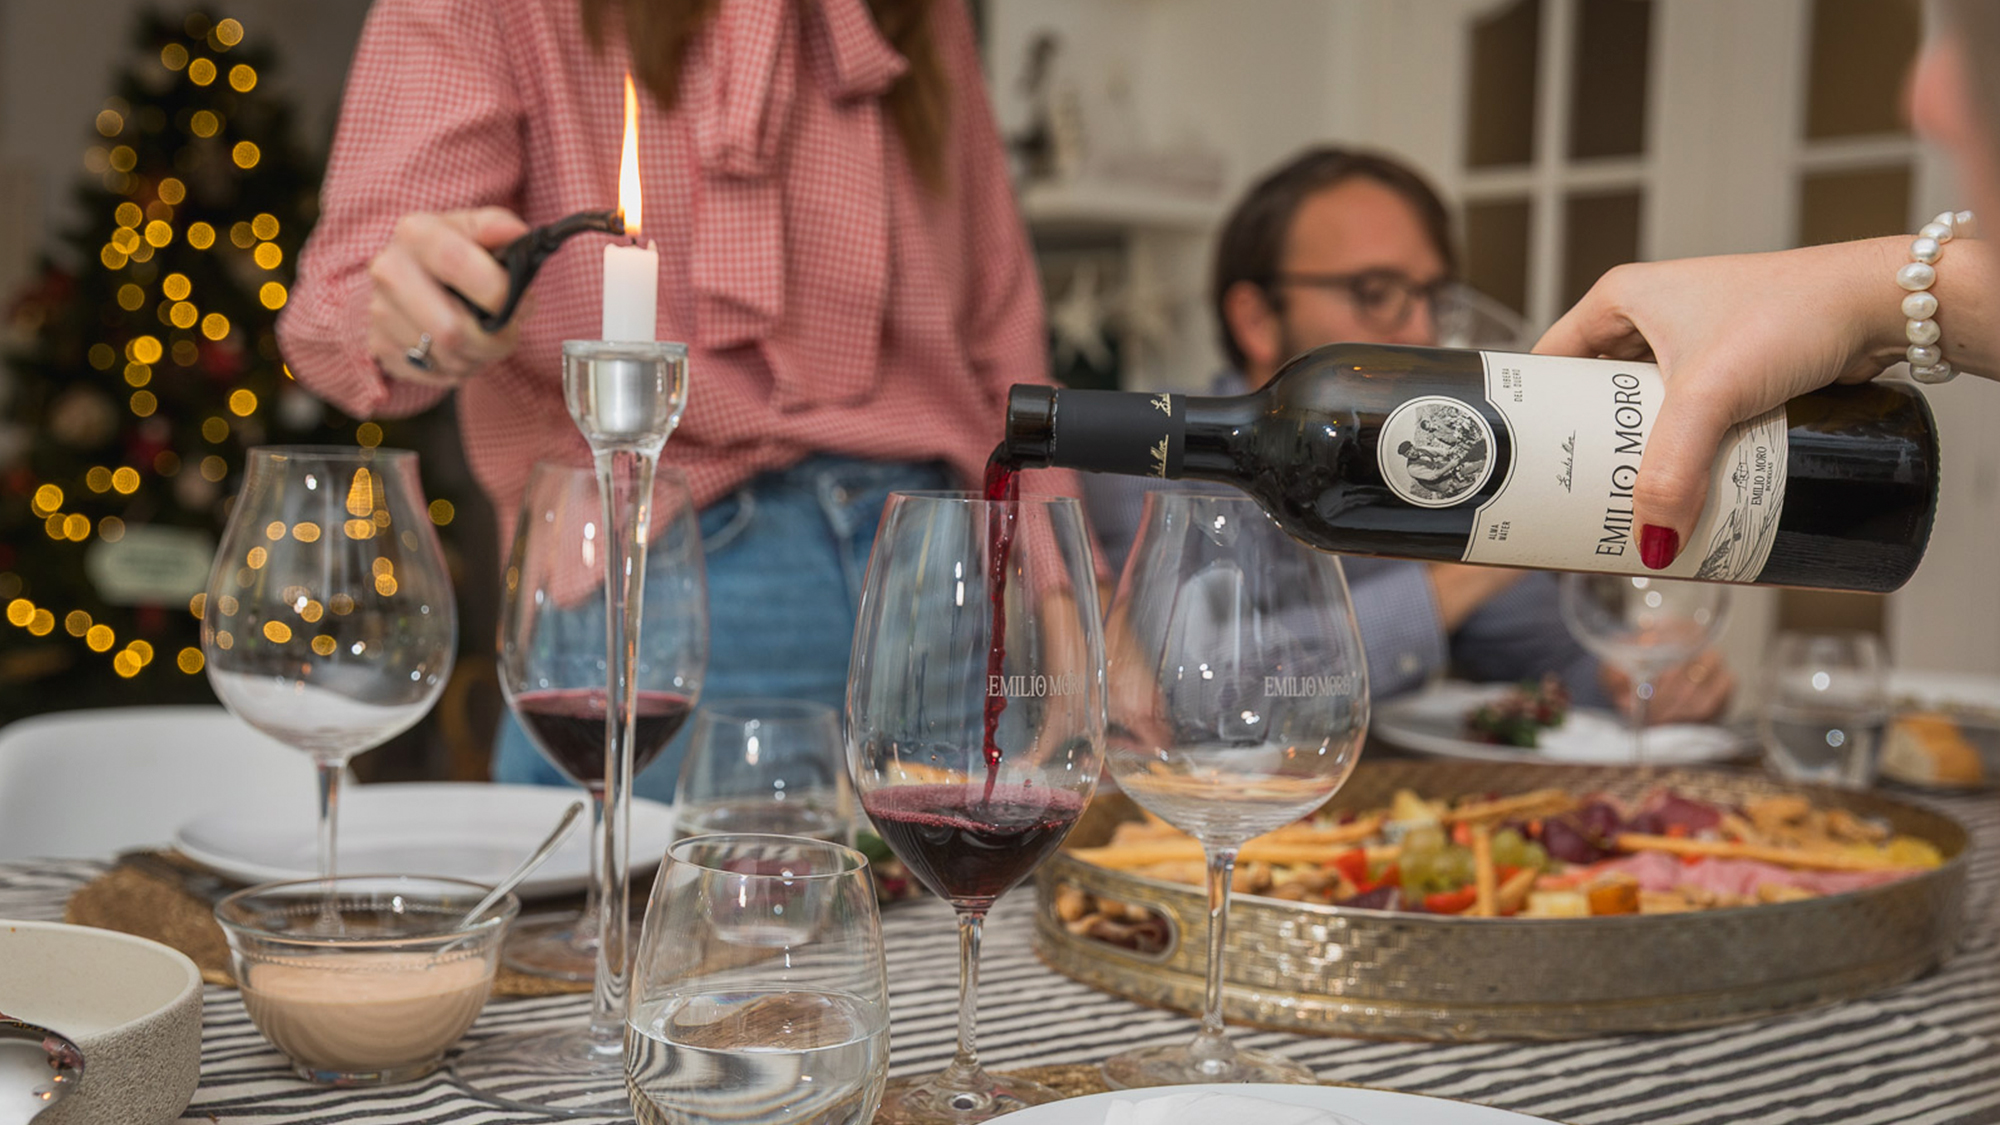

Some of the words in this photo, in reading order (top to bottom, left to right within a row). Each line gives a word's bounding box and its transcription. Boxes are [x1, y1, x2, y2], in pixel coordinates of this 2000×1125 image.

[1514, 390, 1523, 402] DEL
[1612, 373, 1642, 456] MORO
[1755, 446, 1767, 472] MORO
[1751, 475, 1765, 505] EMILIO
[1595, 465, 1638, 556] EMILIO
[1488, 525, 1498, 540] ALMA
[988, 675, 1047, 697] EMILIO
[1264, 676, 1316, 697] EMILIO
[1318, 675, 1351, 696] MORO
